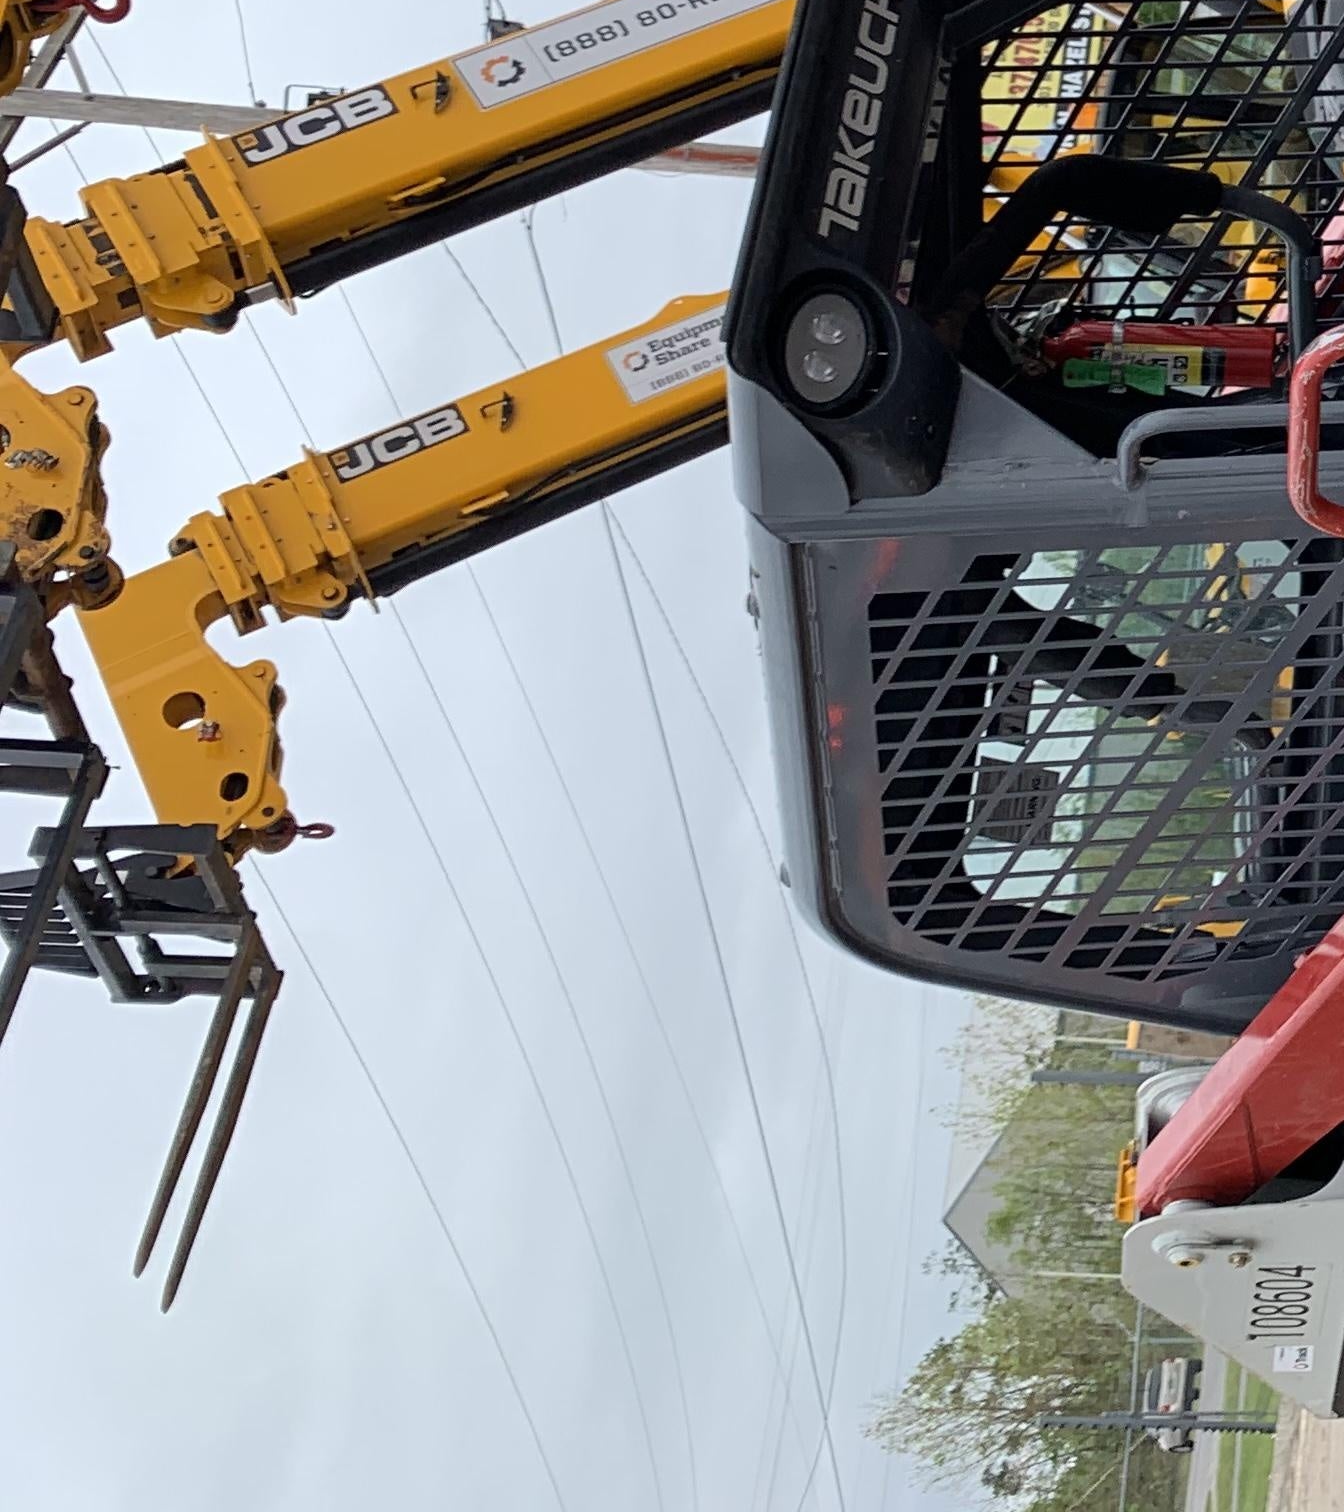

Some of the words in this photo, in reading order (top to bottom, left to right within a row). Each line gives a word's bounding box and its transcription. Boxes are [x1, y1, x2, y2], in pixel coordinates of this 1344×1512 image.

[543, 19, 630, 62] (888)
[243, 89, 393, 162] JCB
[336, 408, 466, 478] JCB
[1247, 1264, 1316, 1341] 108604
